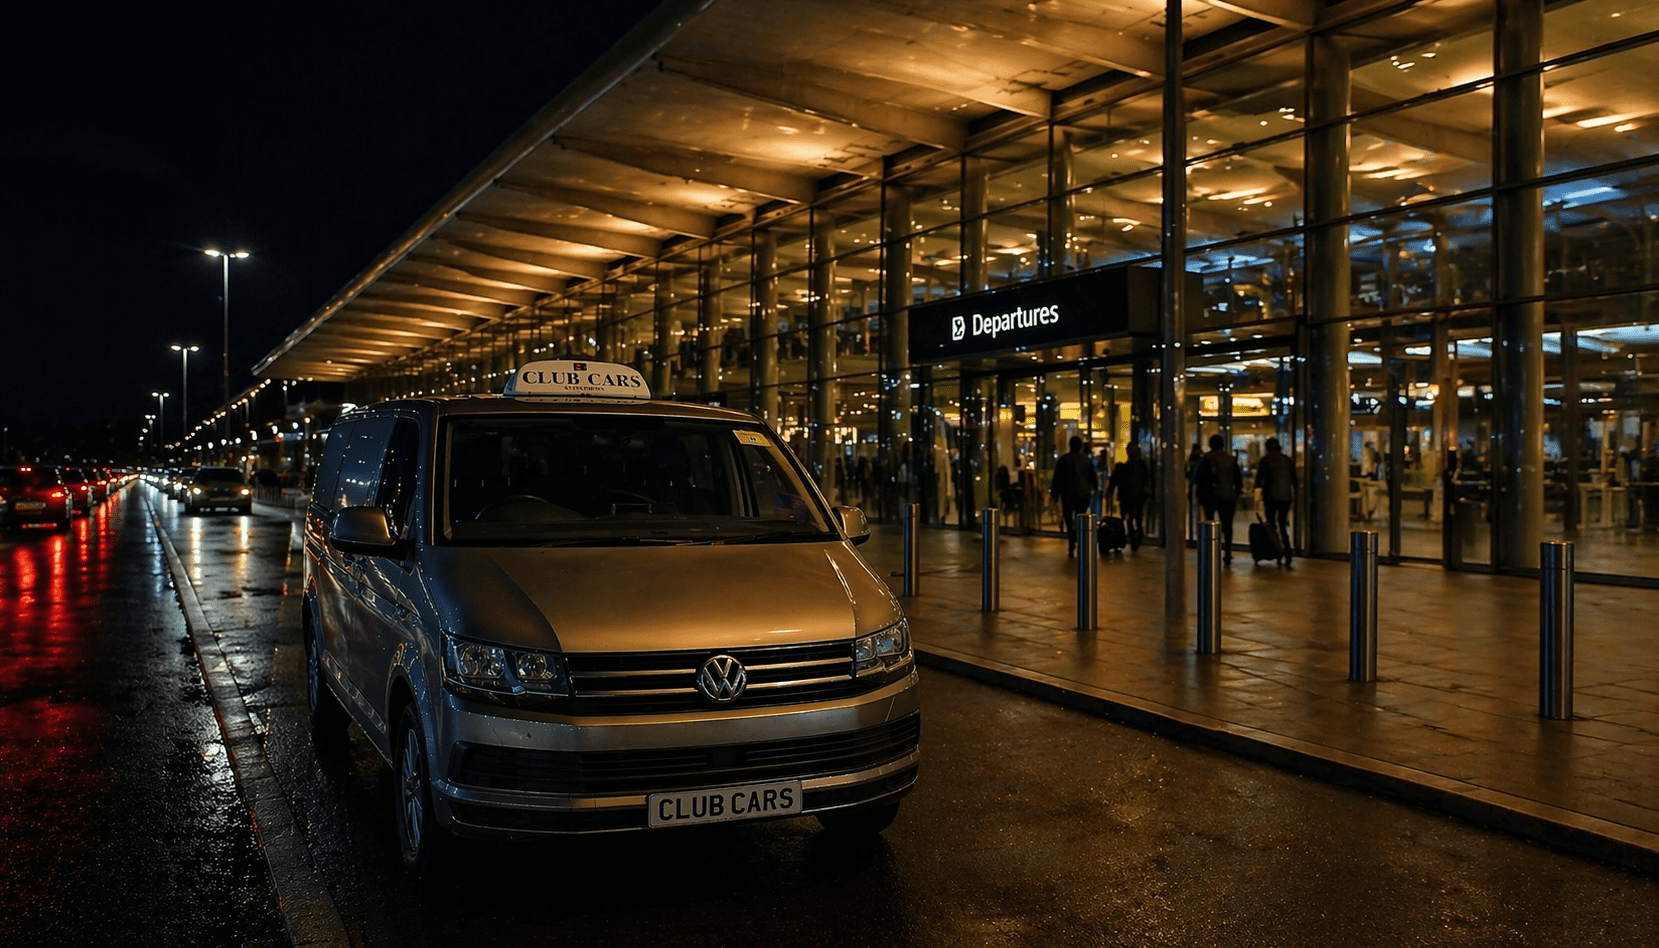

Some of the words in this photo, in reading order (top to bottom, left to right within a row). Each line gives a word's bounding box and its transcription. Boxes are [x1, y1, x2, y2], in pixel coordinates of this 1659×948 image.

[972, 304, 1059, 339] Departures
[522, 371, 580, 385] CLUB
[588, 373, 641, 388] CARS
[659, 794, 724, 821] CLUB
[731, 788, 793, 814] CARS
